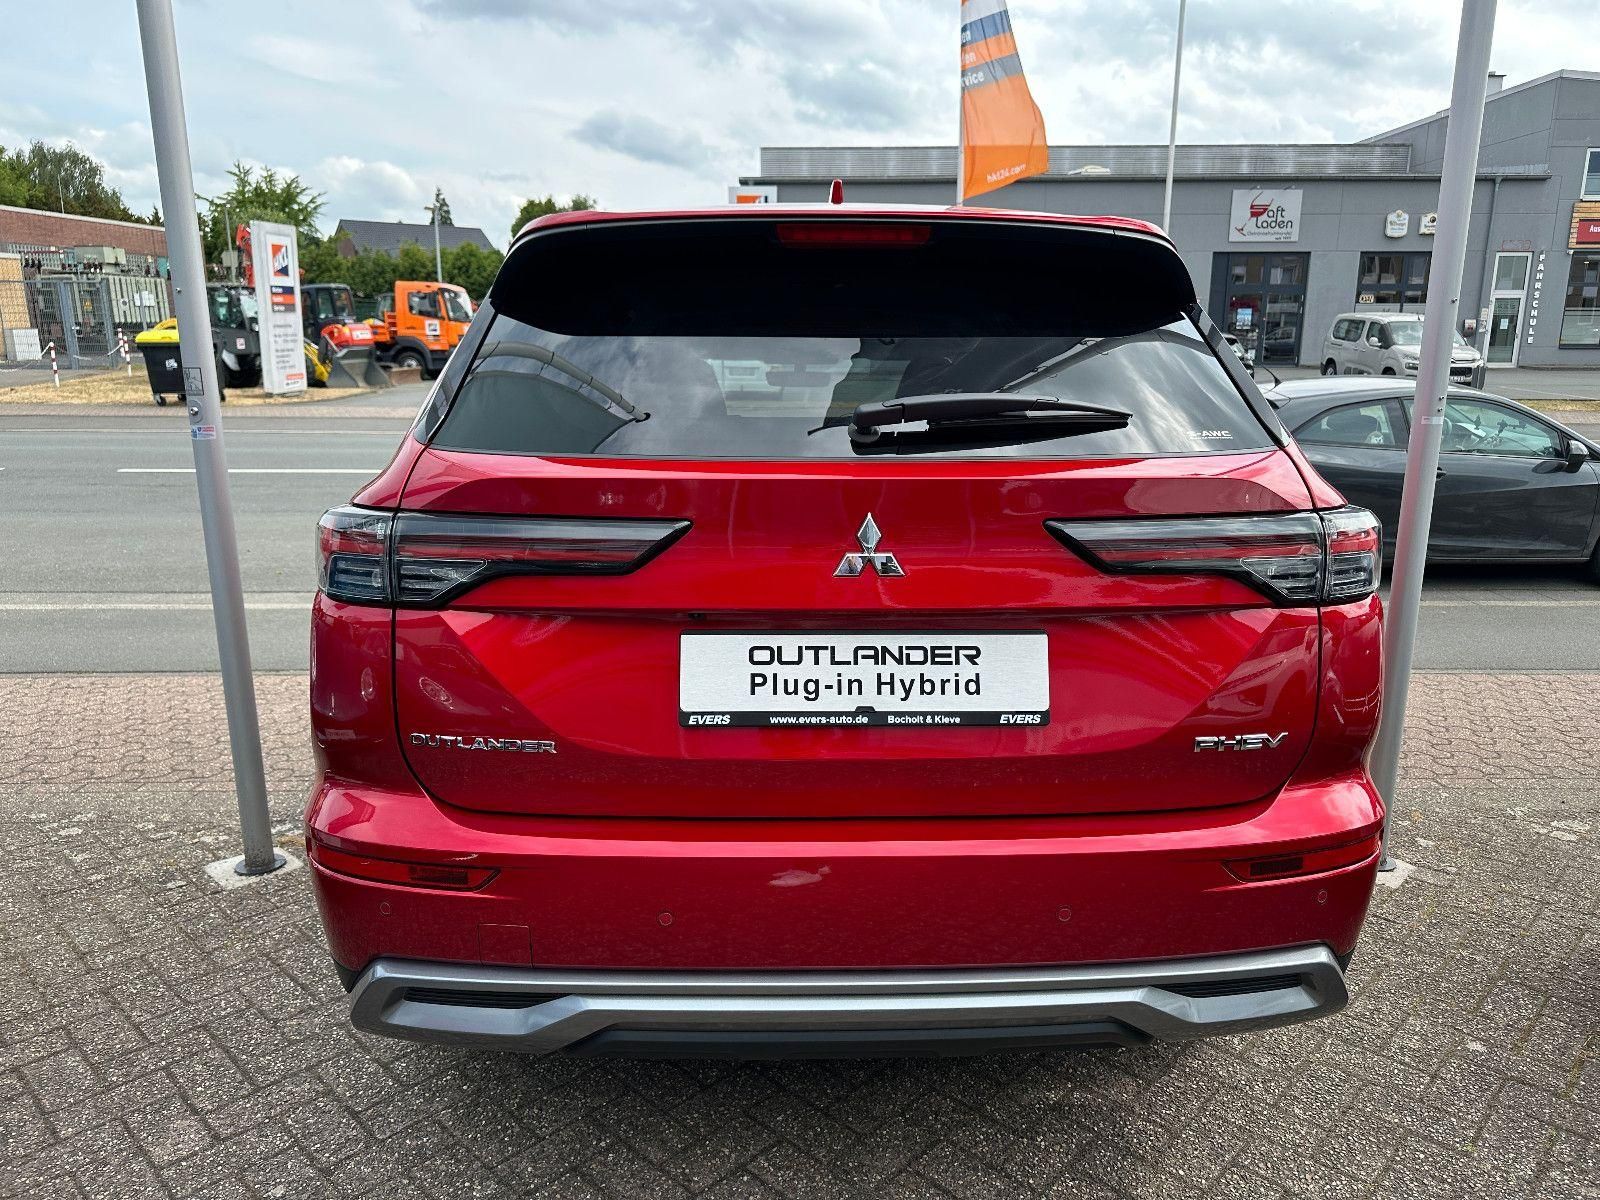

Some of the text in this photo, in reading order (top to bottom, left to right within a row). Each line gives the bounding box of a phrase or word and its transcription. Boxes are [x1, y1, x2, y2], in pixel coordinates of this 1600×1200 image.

[1527, 254, 1545, 344] FAHRSCHULE
[748, 645, 982, 666] OUTLANDER
[749, 672, 982, 701] Plug-in Hybrid
[688, 713, 1042, 725] EVERS www.evers-auto.de Bocholt & Kleve EVERS
[410, 732, 558, 754] OUTLANDER
[1194, 732, 1289, 752] PHEV
